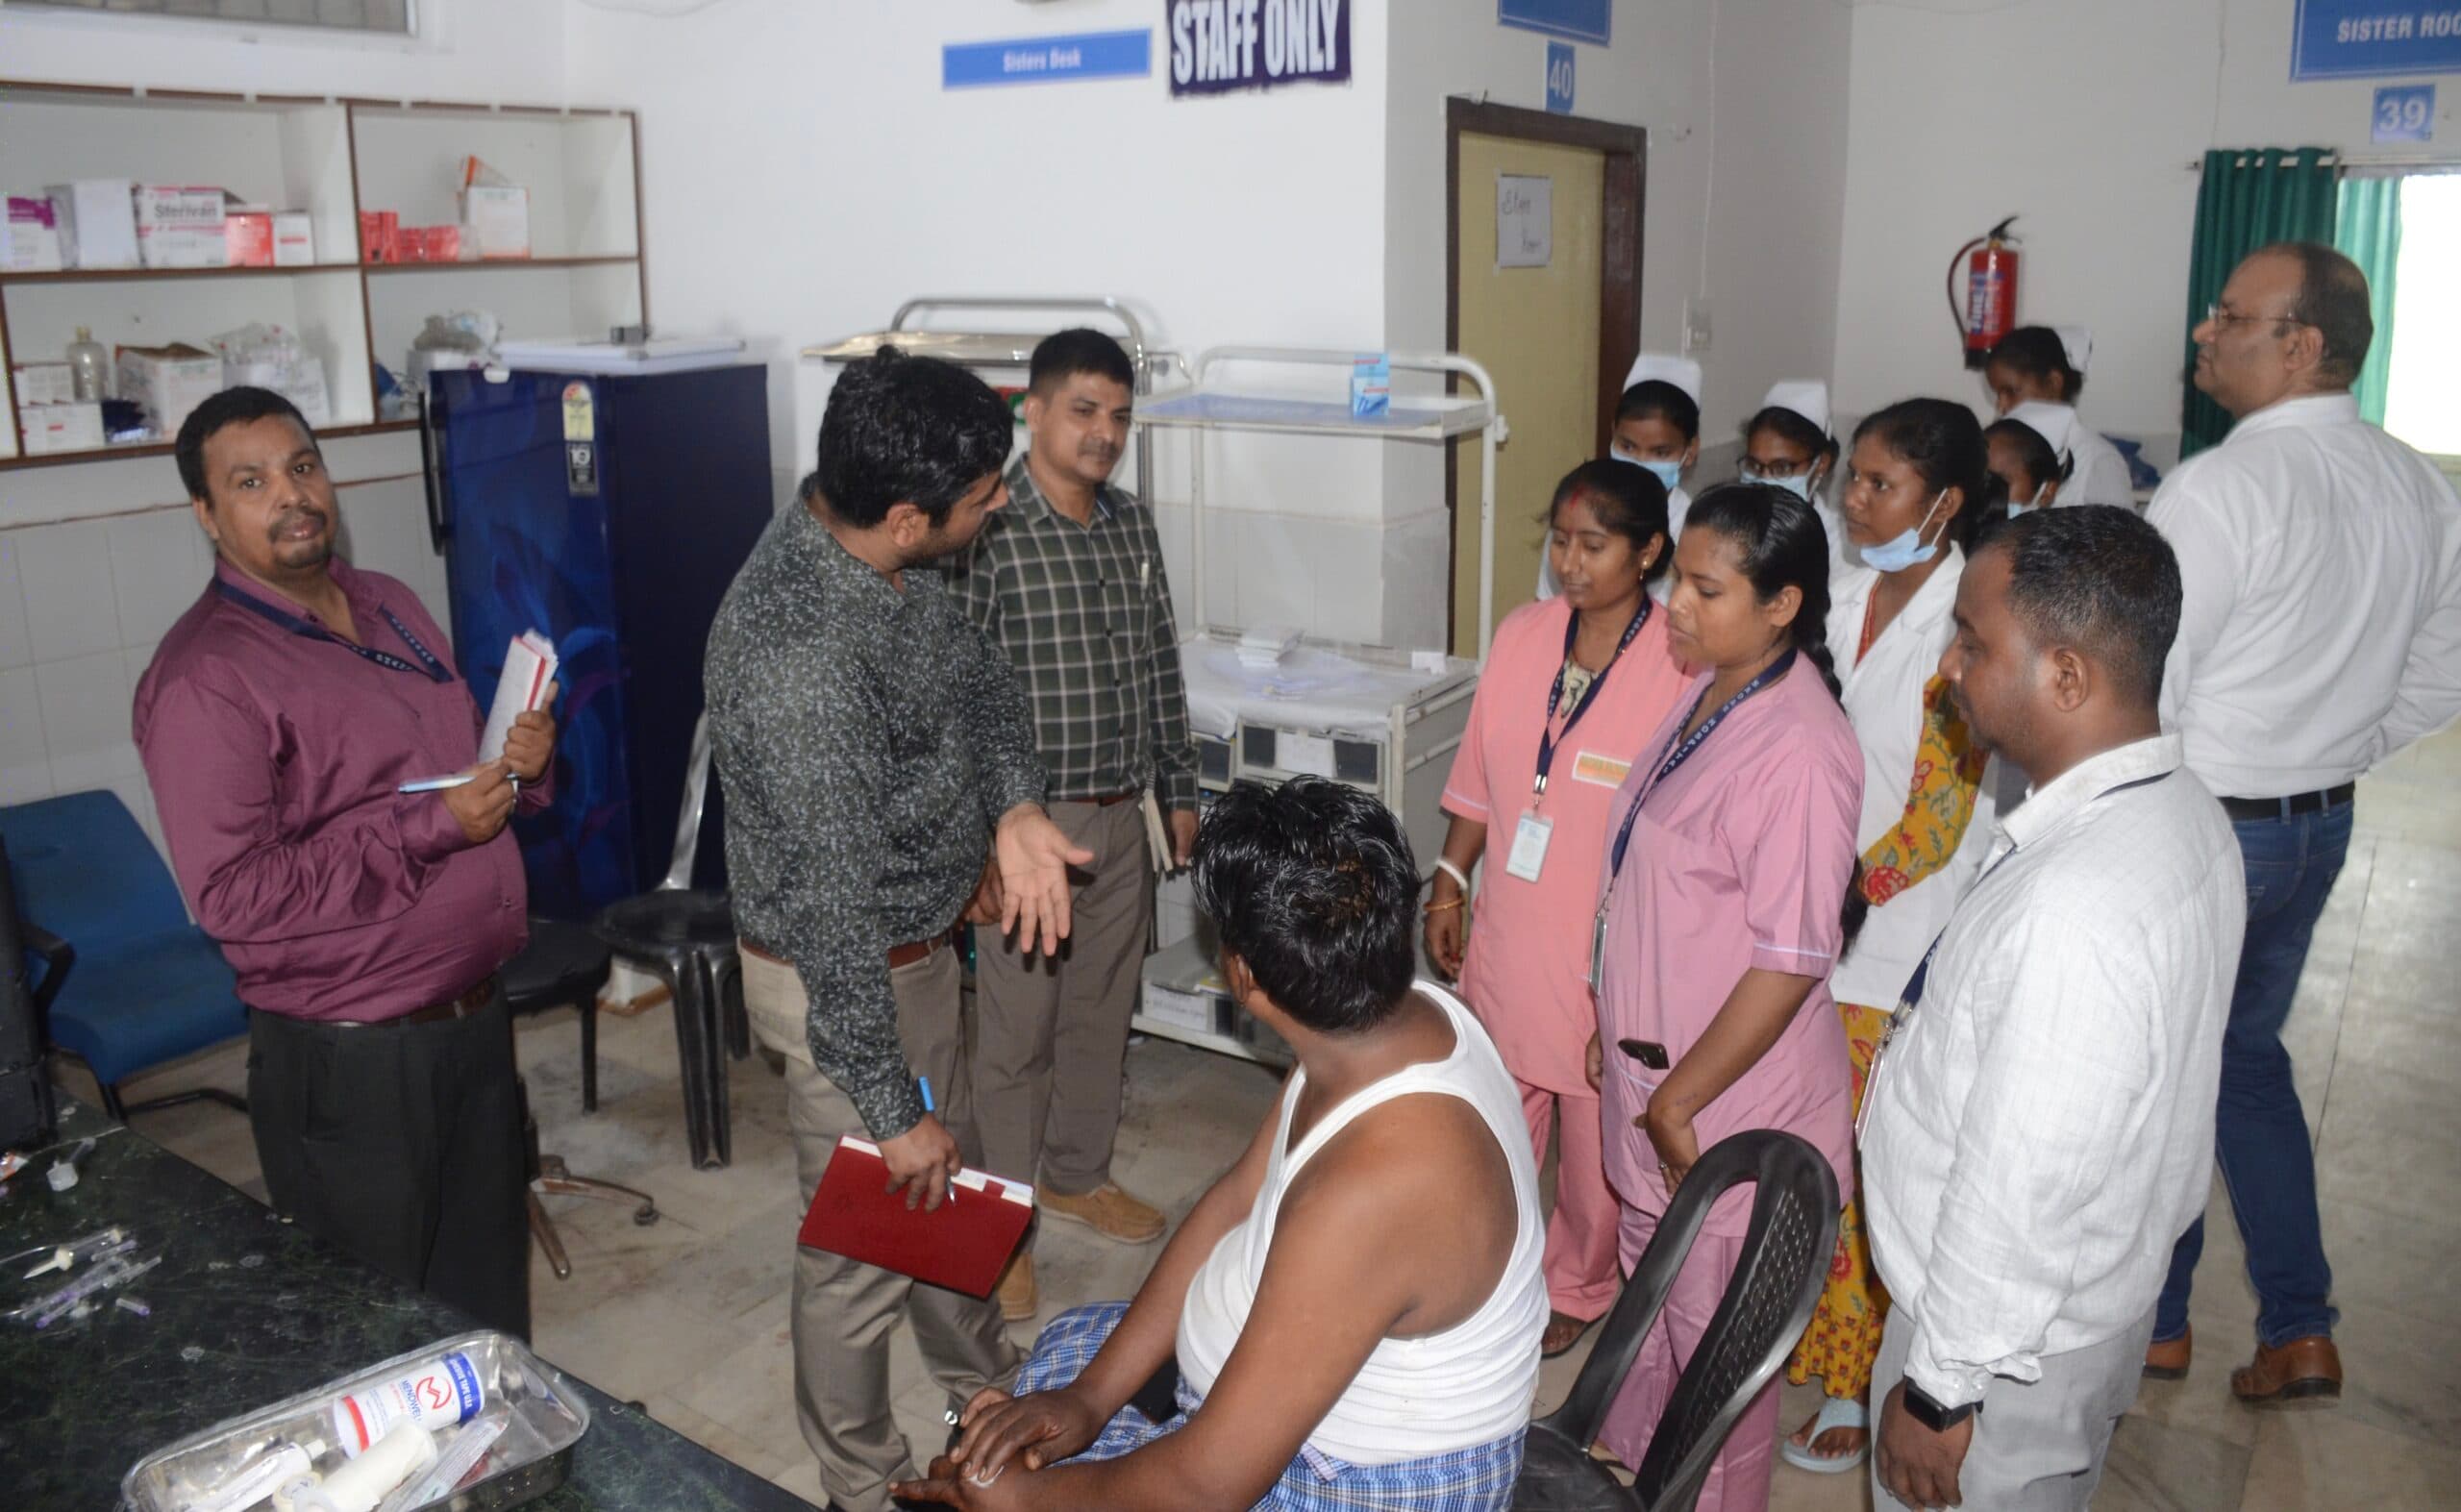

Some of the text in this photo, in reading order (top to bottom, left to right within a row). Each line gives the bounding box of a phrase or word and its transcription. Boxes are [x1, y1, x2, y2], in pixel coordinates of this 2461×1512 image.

[1172, 0, 1339, 85] STAFF ONLY
[2337, 15, 2414, 43] SISTER
[1549, 58, 1573, 99] 40
[2378, 97, 2427, 132] 39
